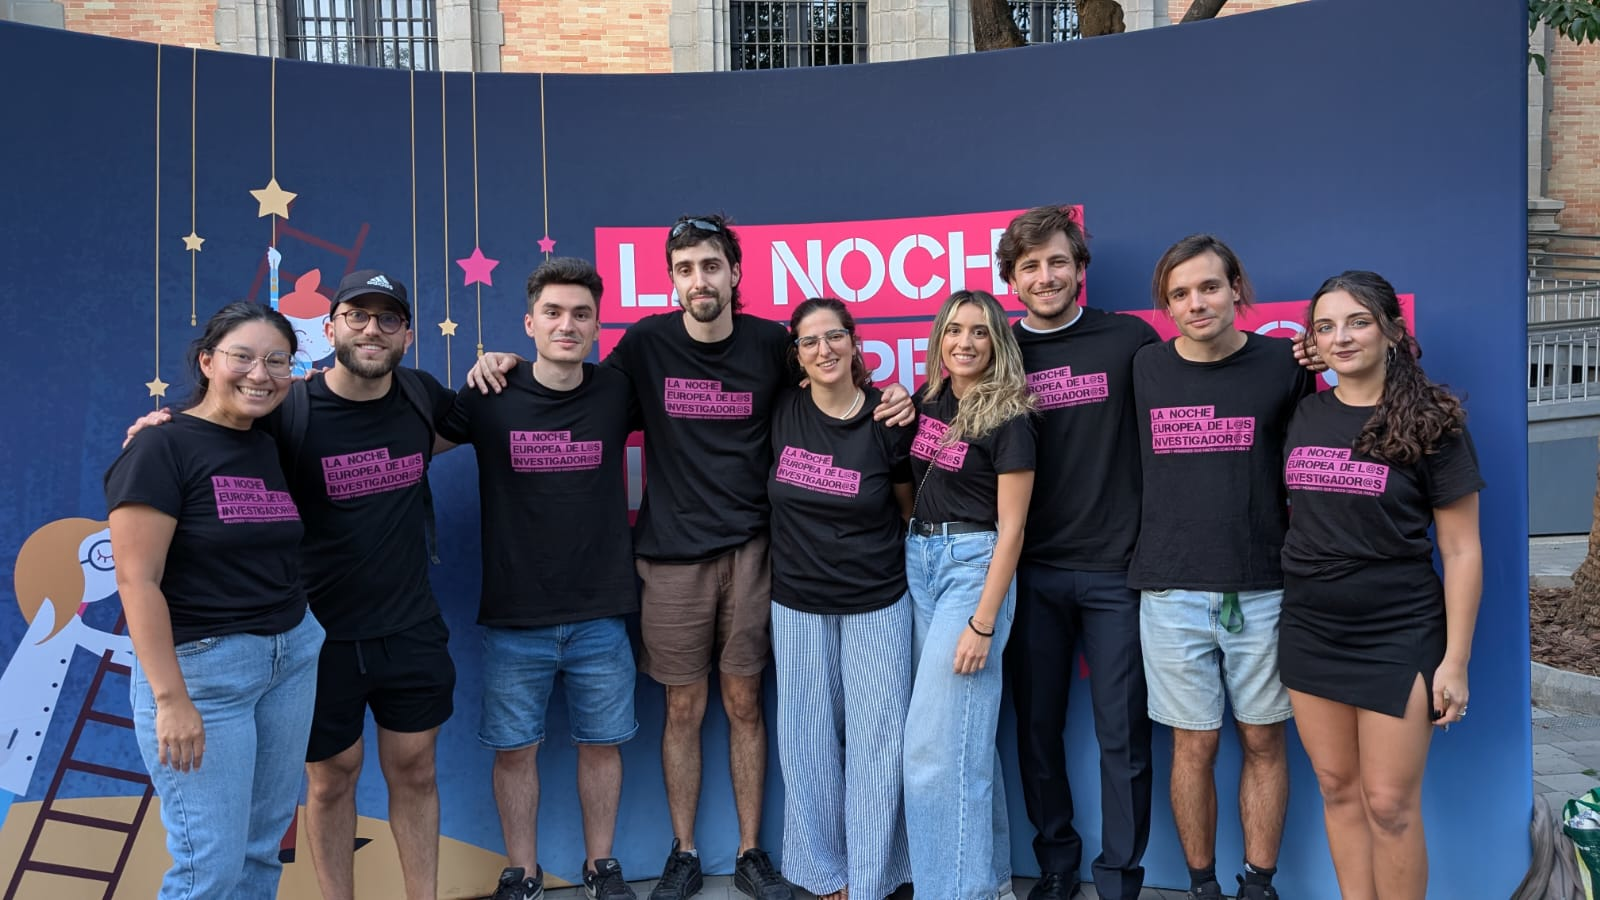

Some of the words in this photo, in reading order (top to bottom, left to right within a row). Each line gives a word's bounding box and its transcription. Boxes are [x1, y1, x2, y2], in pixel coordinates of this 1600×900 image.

[619, 243, 680, 307] L
[771, 228, 1011, 305] NOCH
[1032, 368, 1068, 382] NOCHE
[667, 379, 680, 388] LA
[685, 381, 719, 390] NOCHE
[1026, 381, 1062, 394] ROPEA
[1066, 378, 1080, 387] DE
[667, 391, 712, 401] EUROPEA
[716, 393, 728, 402] DE
[1039, 387, 1106, 404] STIGADOR@S
[667, 403, 750, 414] INVESTIGADOR@S
[1152, 410, 1164, 420] LA
[1169, 408, 1211, 418] NOCHE
[929, 421, 948, 435] NOC
[1153, 422, 1202, 434] EUROPEA
[1207, 420, 1223, 431] DE
[1226, 419, 1252, 430] L@S
[512, 432, 527, 442] LA
[532, 432, 569, 442] NOCHE
[919, 429, 941, 445] ROPE
[1154, 434, 1252, 447] NVESTIGADOR@S
[513, 445, 562, 454] EUROPEA
[566, 444, 579, 453] DE
[1291, 448, 1303, 457] LA
[1307, 448, 1349, 459] NOCHE
[325, 458, 342, 468] LA
[347, 450, 387, 466] NOCHE
[785, 448, 796, 457] LA
[800, 451, 831, 465] NOCHE
[327, 464, 381, 481] EUROPEA
[385, 461, 400, 471] DE
[781, 457, 820, 474] EUROPEA
[825, 468, 837, 477] DE
[1287, 460, 1335, 471] EUROPEA
[1339, 462, 1355, 473] DE
[1358, 463, 1385, 476] L@S
[216, 478, 230, 488] LA
[234, 479, 263, 489] NOCHE
[218, 492, 263, 502] EUROPEA
